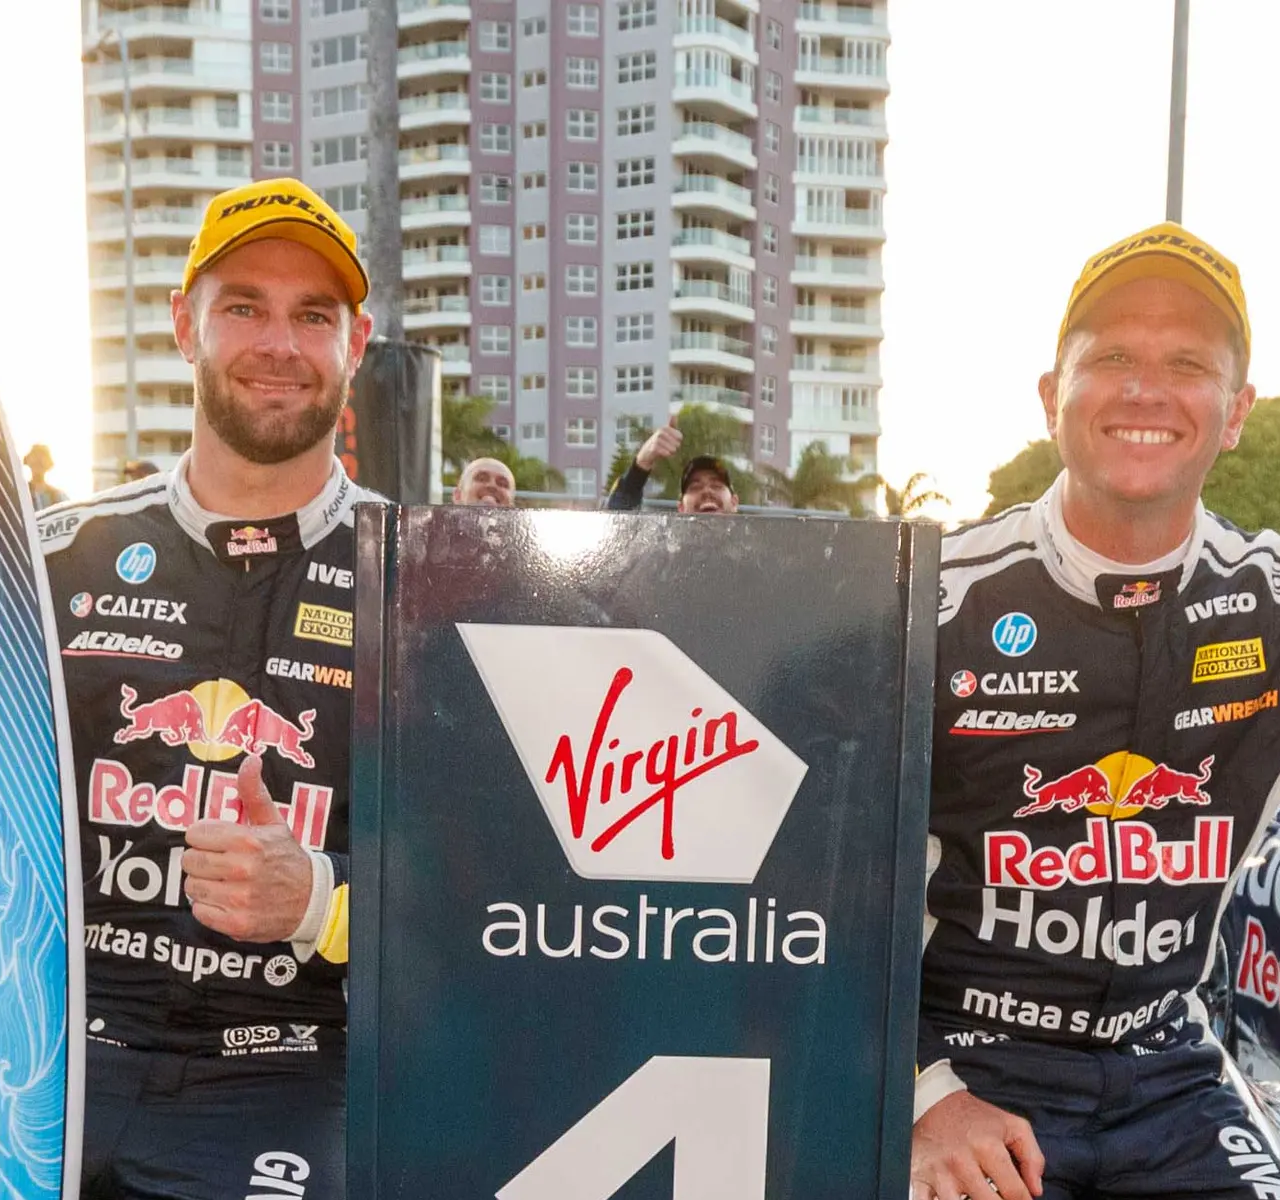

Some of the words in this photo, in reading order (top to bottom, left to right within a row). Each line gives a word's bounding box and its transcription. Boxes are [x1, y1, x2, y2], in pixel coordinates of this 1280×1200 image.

[217, 194, 343, 237] DUNLO
[121, 541, 154, 582] hp
[307, 561, 354, 589] IVE
[95, 594, 188, 625] CALTEX
[1184, 592, 1258, 624] IVECO
[67, 630, 184, 660] ACDelco
[999, 615, 1031, 655] hp
[1195, 655, 1259, 677] STORAGE
[1197, 641, 1260, 663] NATIONAL
[980, 670, 1081, 695] CALTEX
[953, 710, 1078, 730] ACDelco
[545, 667, 760, 860] Virgin
[481, 894, 827, 965] australia
[153, 933, 263, 983] super
[962, 987, 1063, 1030] mtaa
